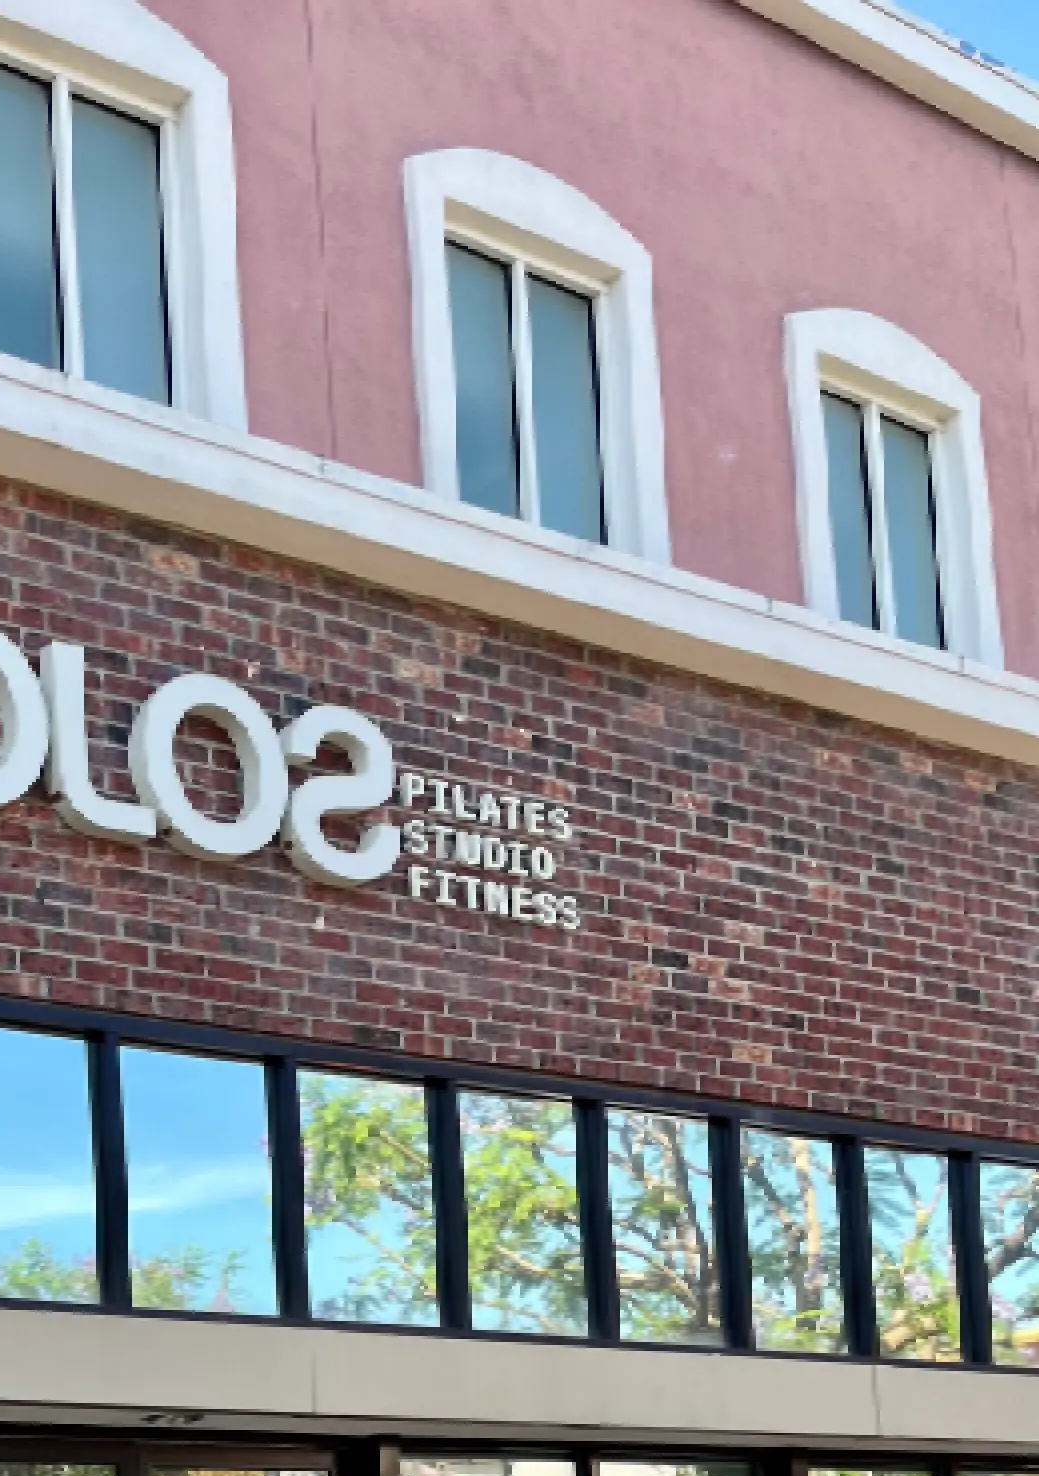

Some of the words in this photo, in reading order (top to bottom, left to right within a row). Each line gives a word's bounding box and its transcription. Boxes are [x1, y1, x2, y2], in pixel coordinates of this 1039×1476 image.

[400, 773, 573, 839] PILATES
[403, 819, 555, 879] STUDIO
[408, 865, 580, 929] FITNESS
